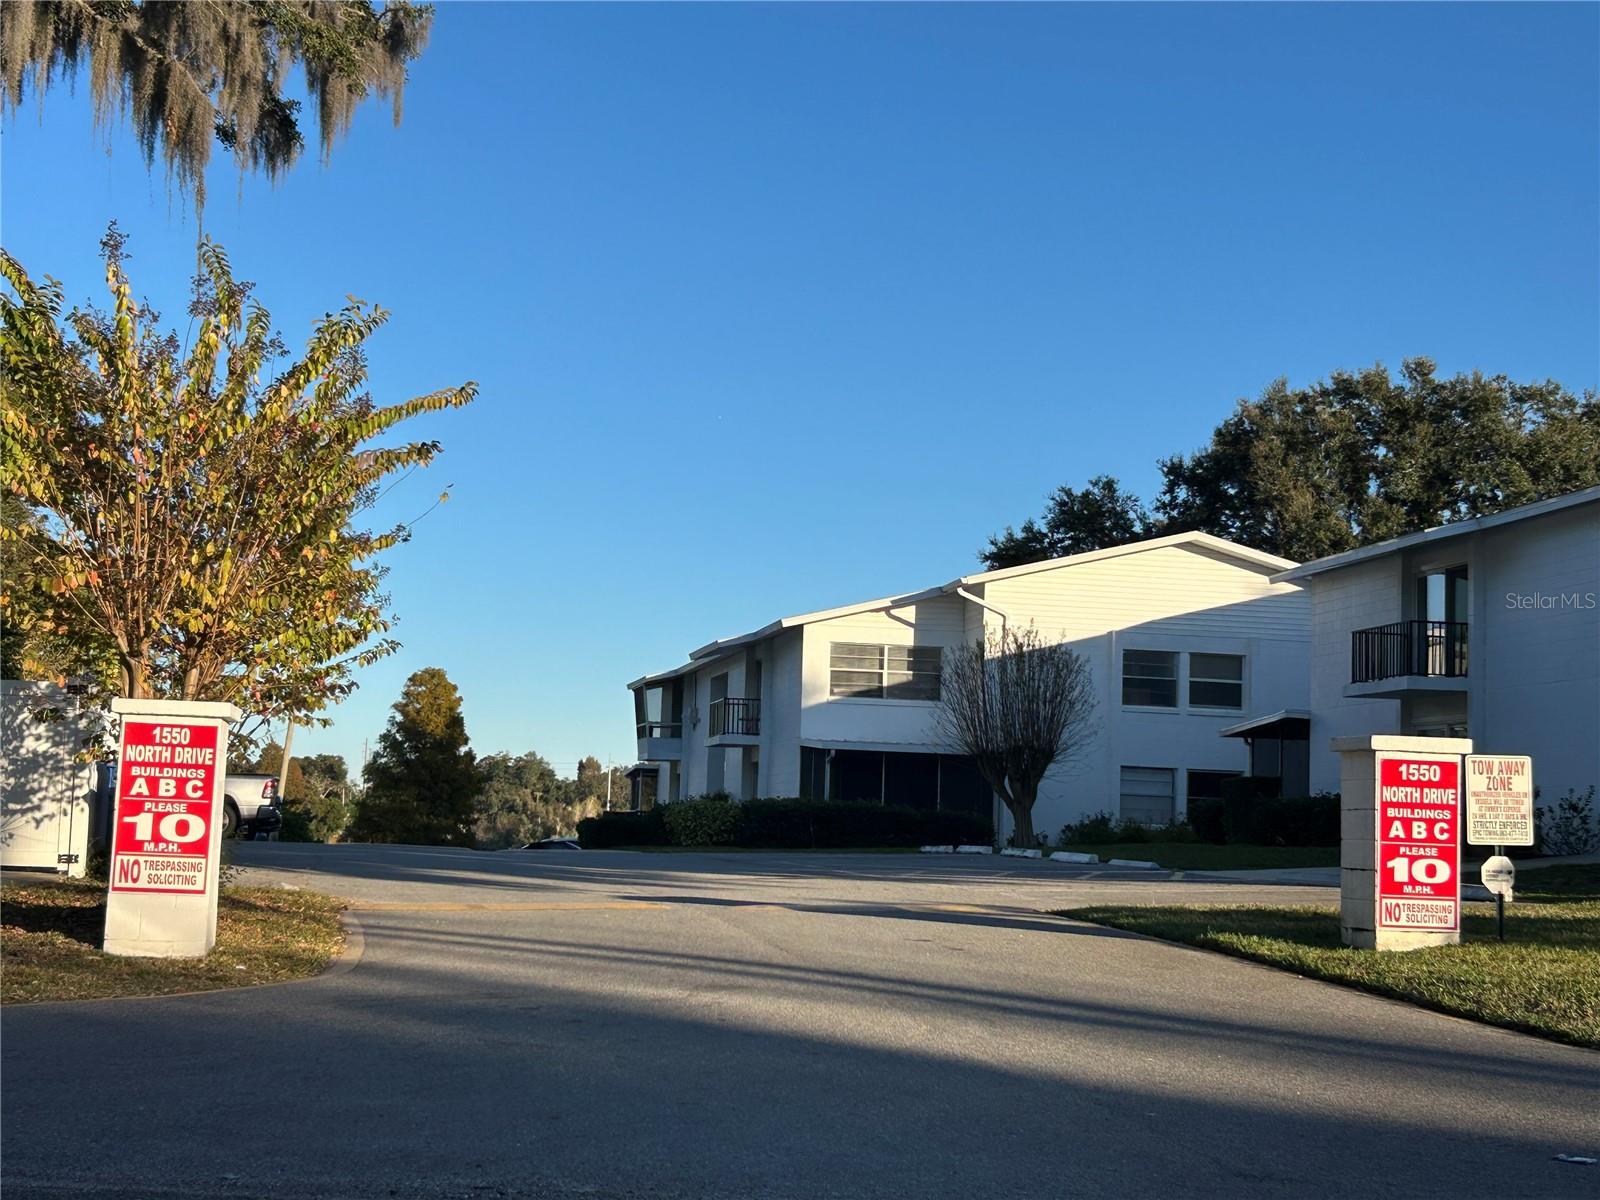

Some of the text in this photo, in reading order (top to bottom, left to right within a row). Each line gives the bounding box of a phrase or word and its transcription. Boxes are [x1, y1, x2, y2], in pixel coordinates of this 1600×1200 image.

[153, 728, 190, 745] 1550
[126, 745, 214, 765] NORTH DRIVE
[132, 766, 205, 778] BUILDINGS
[1398, 764, 1440, 781] 1550
[1471, 760, 1525, 776] TOW AWAY
[130, 778, 204, 798] A B C
[1486, 777, 1512, 791] ZONE
[1382, 786, 1456, 805] NORTH DRIVE
[144, 802, 187, 813] PLEASE
[1387, 808, 1451, 820] BUILDINGS
[123, 812, 206, 843] 10
[1388, 820, 1449, 840] A B C
[1473, 820, 1527, 830] STRICTLY ENFORCED
[144, 842, 181, 853] M.P.H.
[1400, 847, 1438, 856] PLEASE
[119, 858, 202, 884] NO TRESPASSING
[1386, 857, 1451, 884] 10
[147, 873, 196, 885] SOLICITING
[1403, 885, 1434, 894] M.P.H.
[1385, 902, 1452, 923] NO TRESPASSING
[1406, 913, 1448, 924] SOLICITING
